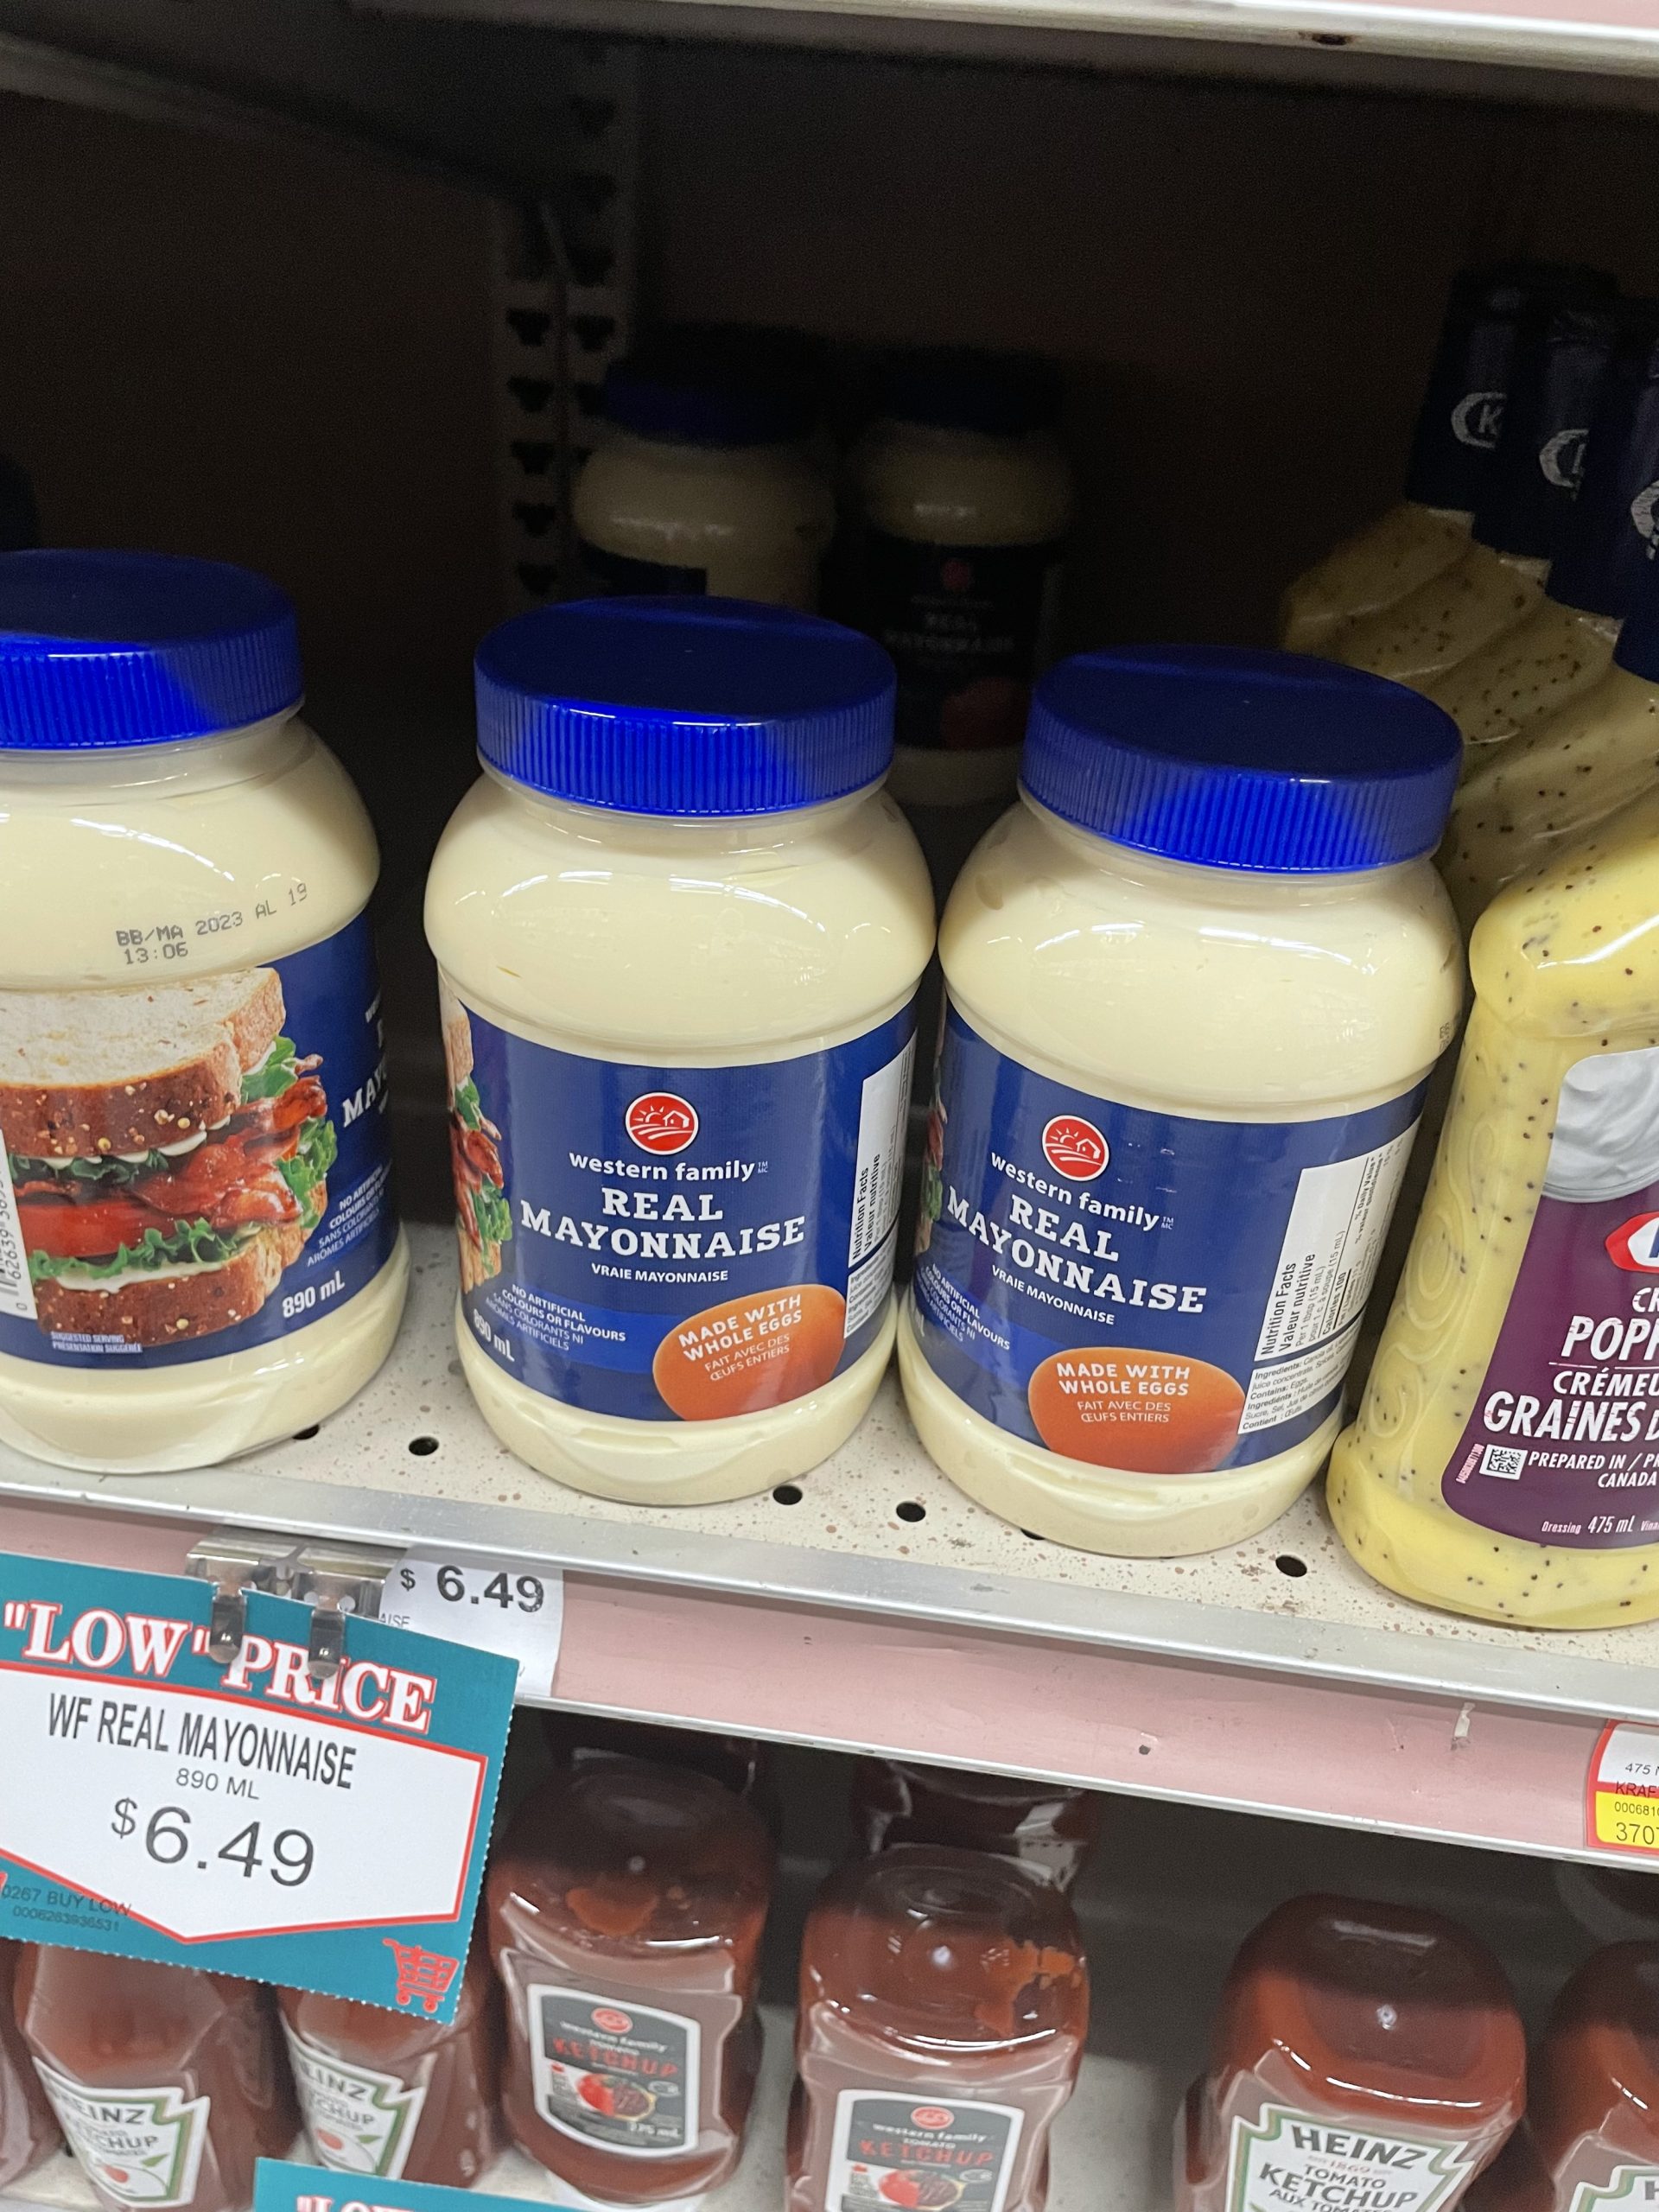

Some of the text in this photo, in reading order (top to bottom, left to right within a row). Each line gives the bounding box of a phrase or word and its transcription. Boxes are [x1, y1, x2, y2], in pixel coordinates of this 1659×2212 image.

[116, 925, 183, 946] BB/MA
[195, 912, 243, 935] 2023
[255, 900, 276, 919] AL
[124, 942, 188, 964] 13:06
[569, 1152, 668, 1180] western
[675, 1160, 754, 1184] family
[340, 1196, 352, 1211] NO
[602, 1187, 723, 1222] REAL
[864, 1154, 880, 1252] Valeur nutritive
[990, 1152, 1073, 1205] western
[1078, 1192, 1160, 1230] family
[520, 1200, 805, 1259] MAYONNAISE
[852, 1167, 869, 1260] Nutrition Facts
[1009, 1193, 1120, 1261] REAL
[319, 1227, 341, 1249] SANS
[946, 1186, 1207, 1313] MAYONNAISE
[591, 1263, 728, 1283] VRAIE MAYONNAISE
[283, 1270, 345, 1318] 890 mL
[512, 1284, 586, 1322] NO ARTIFICIAL
[941, 1277, 980, 1319] ARTIFICIAL
[991, 1266, 1115, 1325] VRAIE MAYONNAISE
[1261, 1262, 1296, 1356] Nutrition Facts
[1279, 1254, 1316, 1352] Valeur nutritive
[502, 1289, 626, 1342] COLOURS OR FLAVOURS
[514, 1307, 570, 1339] COLORANTS
[572, 1333, 583, 1345] NI
[678, 1294, 802, 1346] MADE WITH
[951, 1300, 962, 1315] OR
[963, 1311, 1010, 1351] FLAVOURS
[1309, 1319, 1319, 1343] pour
[1322, 1293, 1341, 1336] Calories
[474, 1308, 515, 1362] 890 mL
[516, 1320, 569, 1351] ARTIFICIELS
[683, 1309, 802, 1361] WHOLE EGGS
[704, 1334, 790, 1373] FAIT AVEC DES
[746, 1344, 790, 1370] ENTIERS
[1057, 1362, 1191, 1381] MADE WITH
[1255, 1361, 1302, 1381] Ingredients:
[1058, 1379, 1189, 1397] WHOLE EGGS
[1077, 1400, 1172, 1413] FAIT AVEC DES
[1250, 1384, 1288, 1400] Contains:
[1119, 1412, 1170, 1424] ENTIERS
[1243, 1416, 1277, 1430] Contient
[1483, 1390, 1647, 1441] GRAINES
[1528, 1451, 1605, 1470] PREPARED
[1608, 1454, 1627, 1469] IN
[1598, 1471, 1657, 1488] CANADA
[1541, 1521, 1582, 1535] Dressing
[1588, 1516, 1615, 1534] 475
[1616, 1515, 1636, 1533] mL
[400, 1565, 544, 1612] $ 6.49
[220, 1633, 437, 1735] PRICE
[48, 1692, 357, 1789] WF REAL MAYONNAISE
[175, 1766, 260, 1801] 890 ML
[1625, 1763, 1651, 1776] 475
[1615, 1781, 1659, 1798] KRAF
[1616, 1822, 1659, 1845] 370
[47, 1891, 85, 1909] BUY
[89, 1898, 132, 1916] LOW
[552, 2037, 678, 2078] KETCHUP
[859, 2139, 994, 2166] KETCHUP
[1292, 2125, 1427, 2170] HEINZ
[1259, 2162, 1419, 2209] KETCHUP
[1304, 2164, 1386, 2189] TOMATO
[1269, 2189, 1306, 2208] AUX
